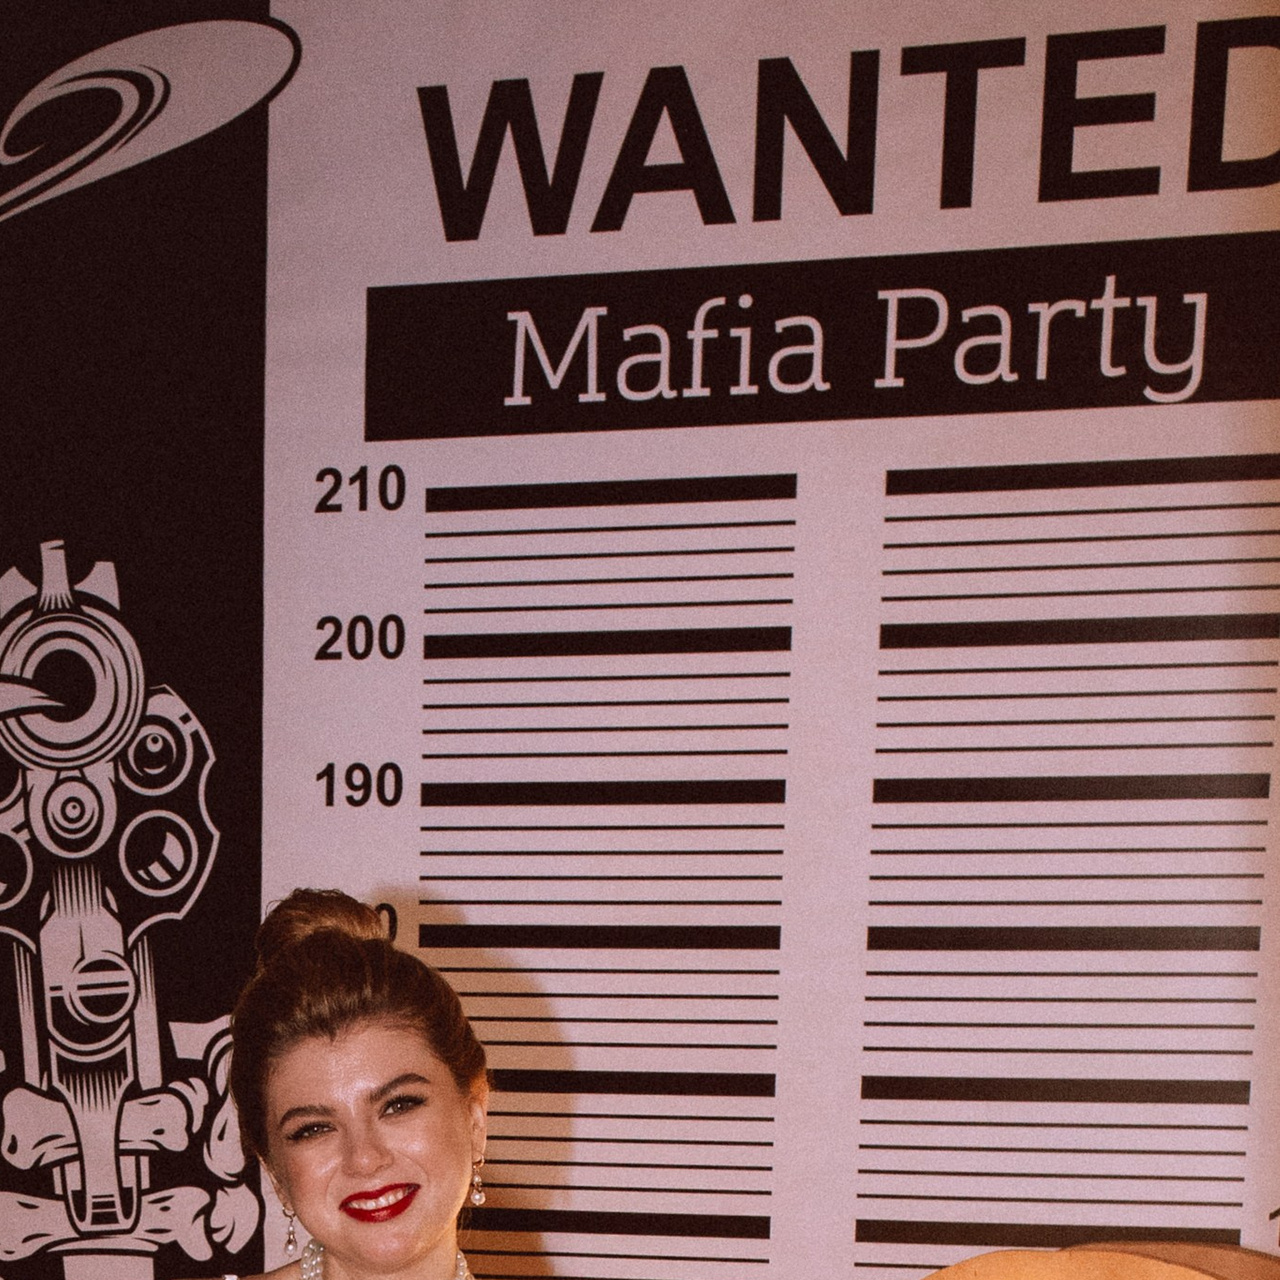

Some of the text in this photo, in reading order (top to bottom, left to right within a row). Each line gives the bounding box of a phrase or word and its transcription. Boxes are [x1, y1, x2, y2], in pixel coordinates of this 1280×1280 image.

[415, 14, 1280, 243] WANTED
[503, 274, 1208, 406] Mafia Party
[314, 464, 407, 514] 210
[314, 613, 407, 661] 200
[314, 762, 404, 808] 190
